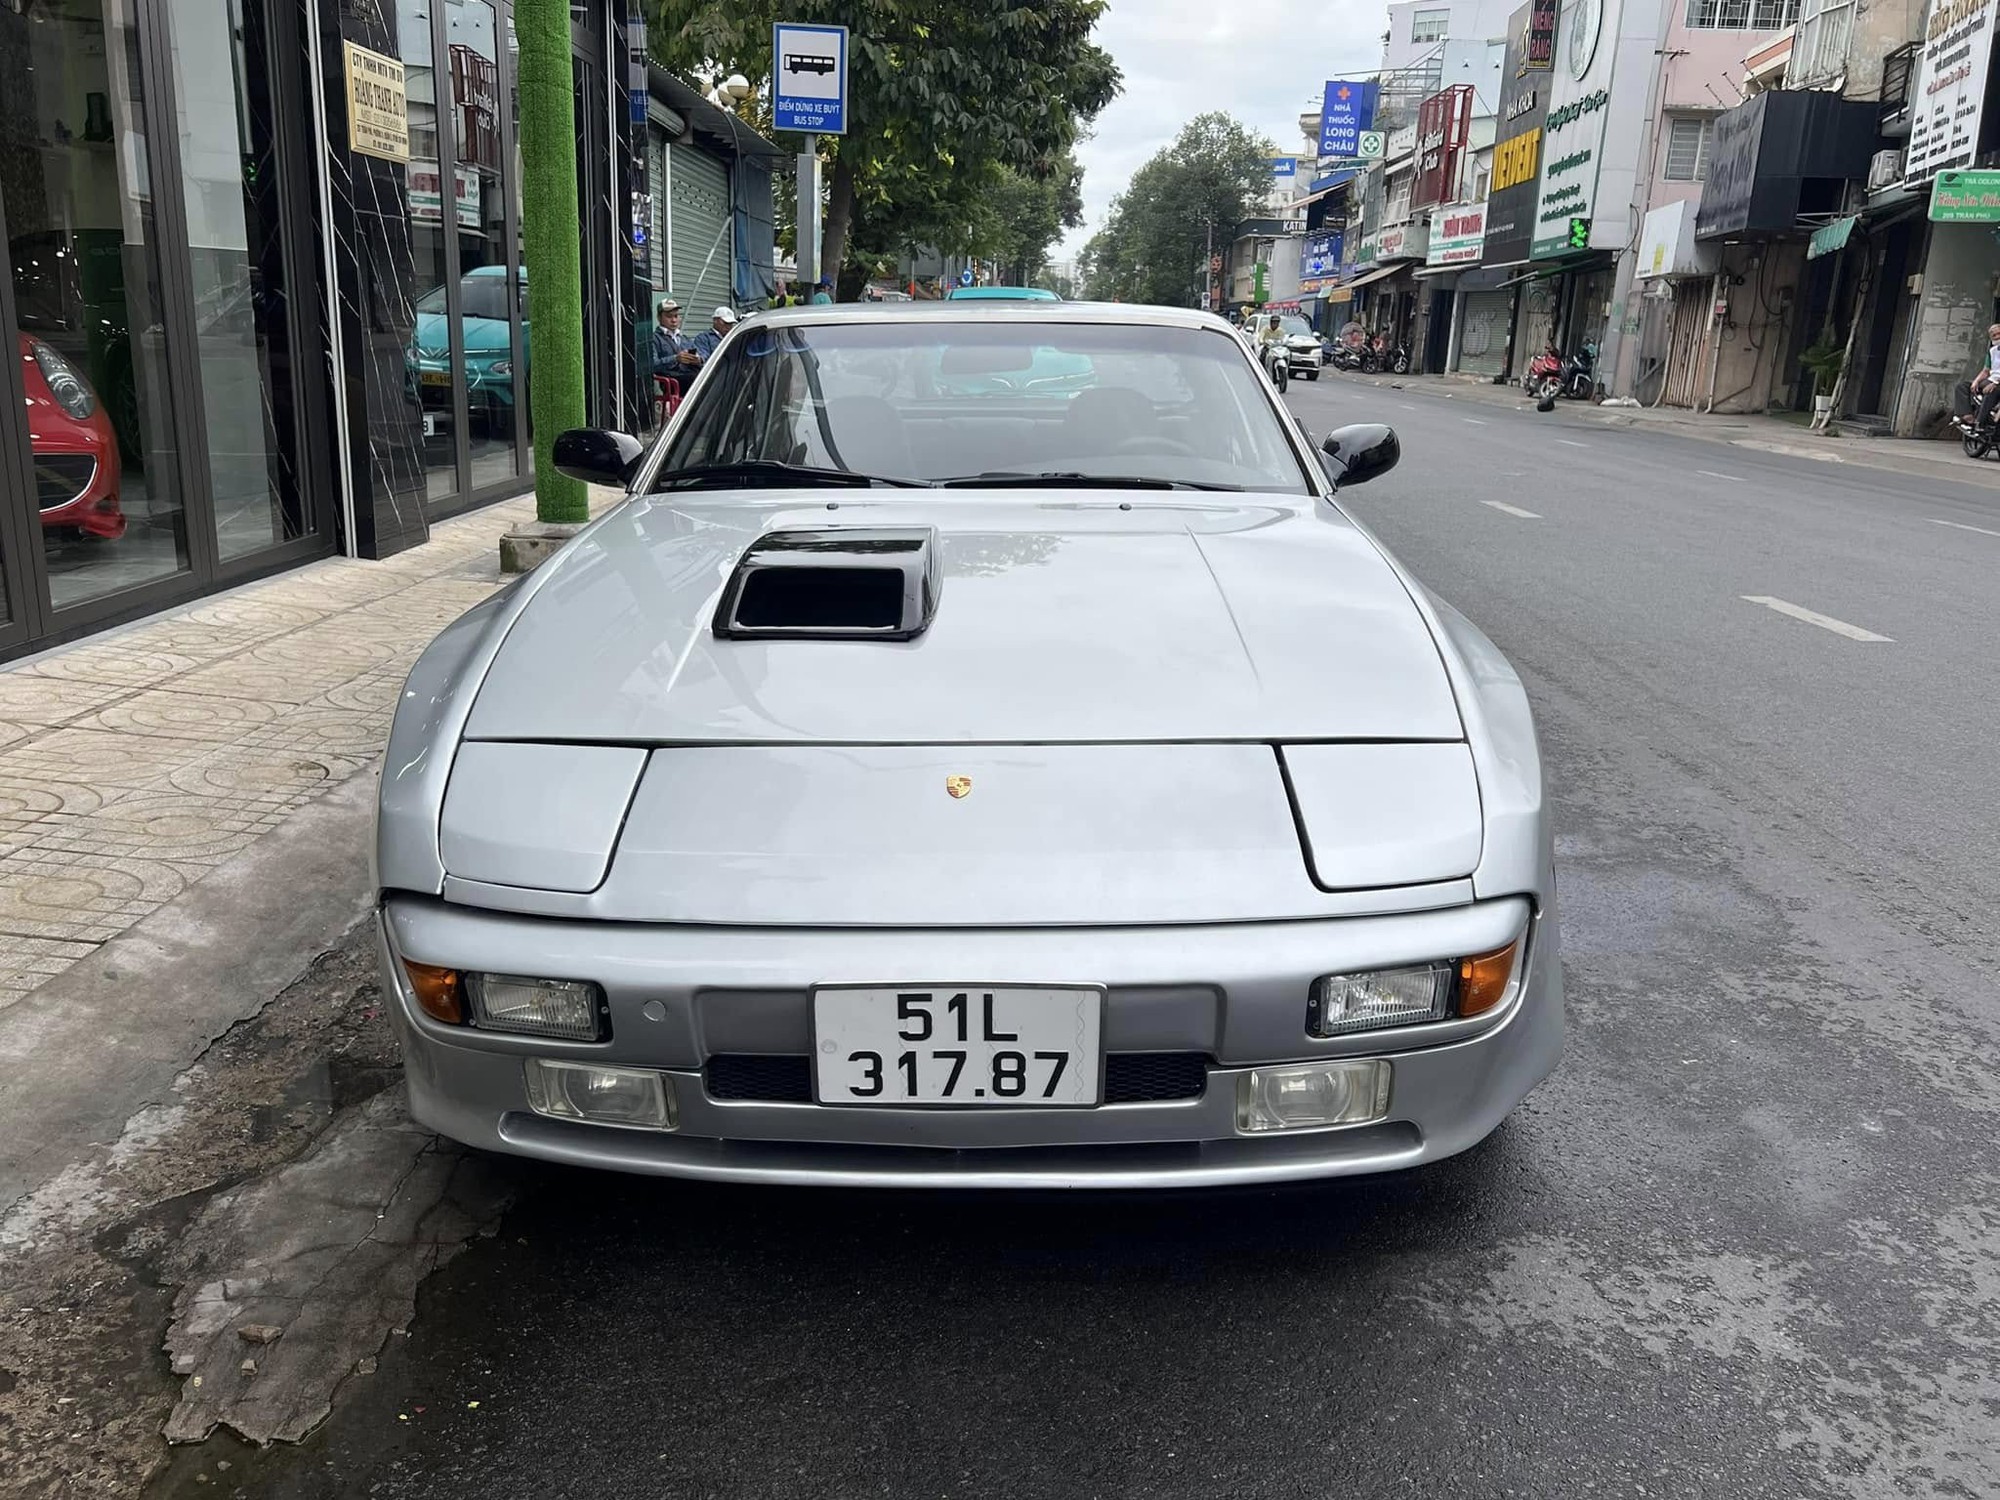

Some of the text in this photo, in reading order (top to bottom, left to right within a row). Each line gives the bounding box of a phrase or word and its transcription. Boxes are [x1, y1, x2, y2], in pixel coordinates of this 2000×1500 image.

[778, 98, 840, 114] ĐIỂM DỪNG XE BUÝT
[1333, 102, 1351, 112] NHÀ
[793, 115, 824, 126] BUS STOP
[1328, 114, 1356, 125] THUỐC
[1325, 127, 1355, 137] LONG
[1324, 139, 1354, 151] CHÂU
[1282, 220, 1307, 232] KATIN
[897, 993, 1018, 1042] 51L
[848, 1050, 1069, 1098] 317.87
